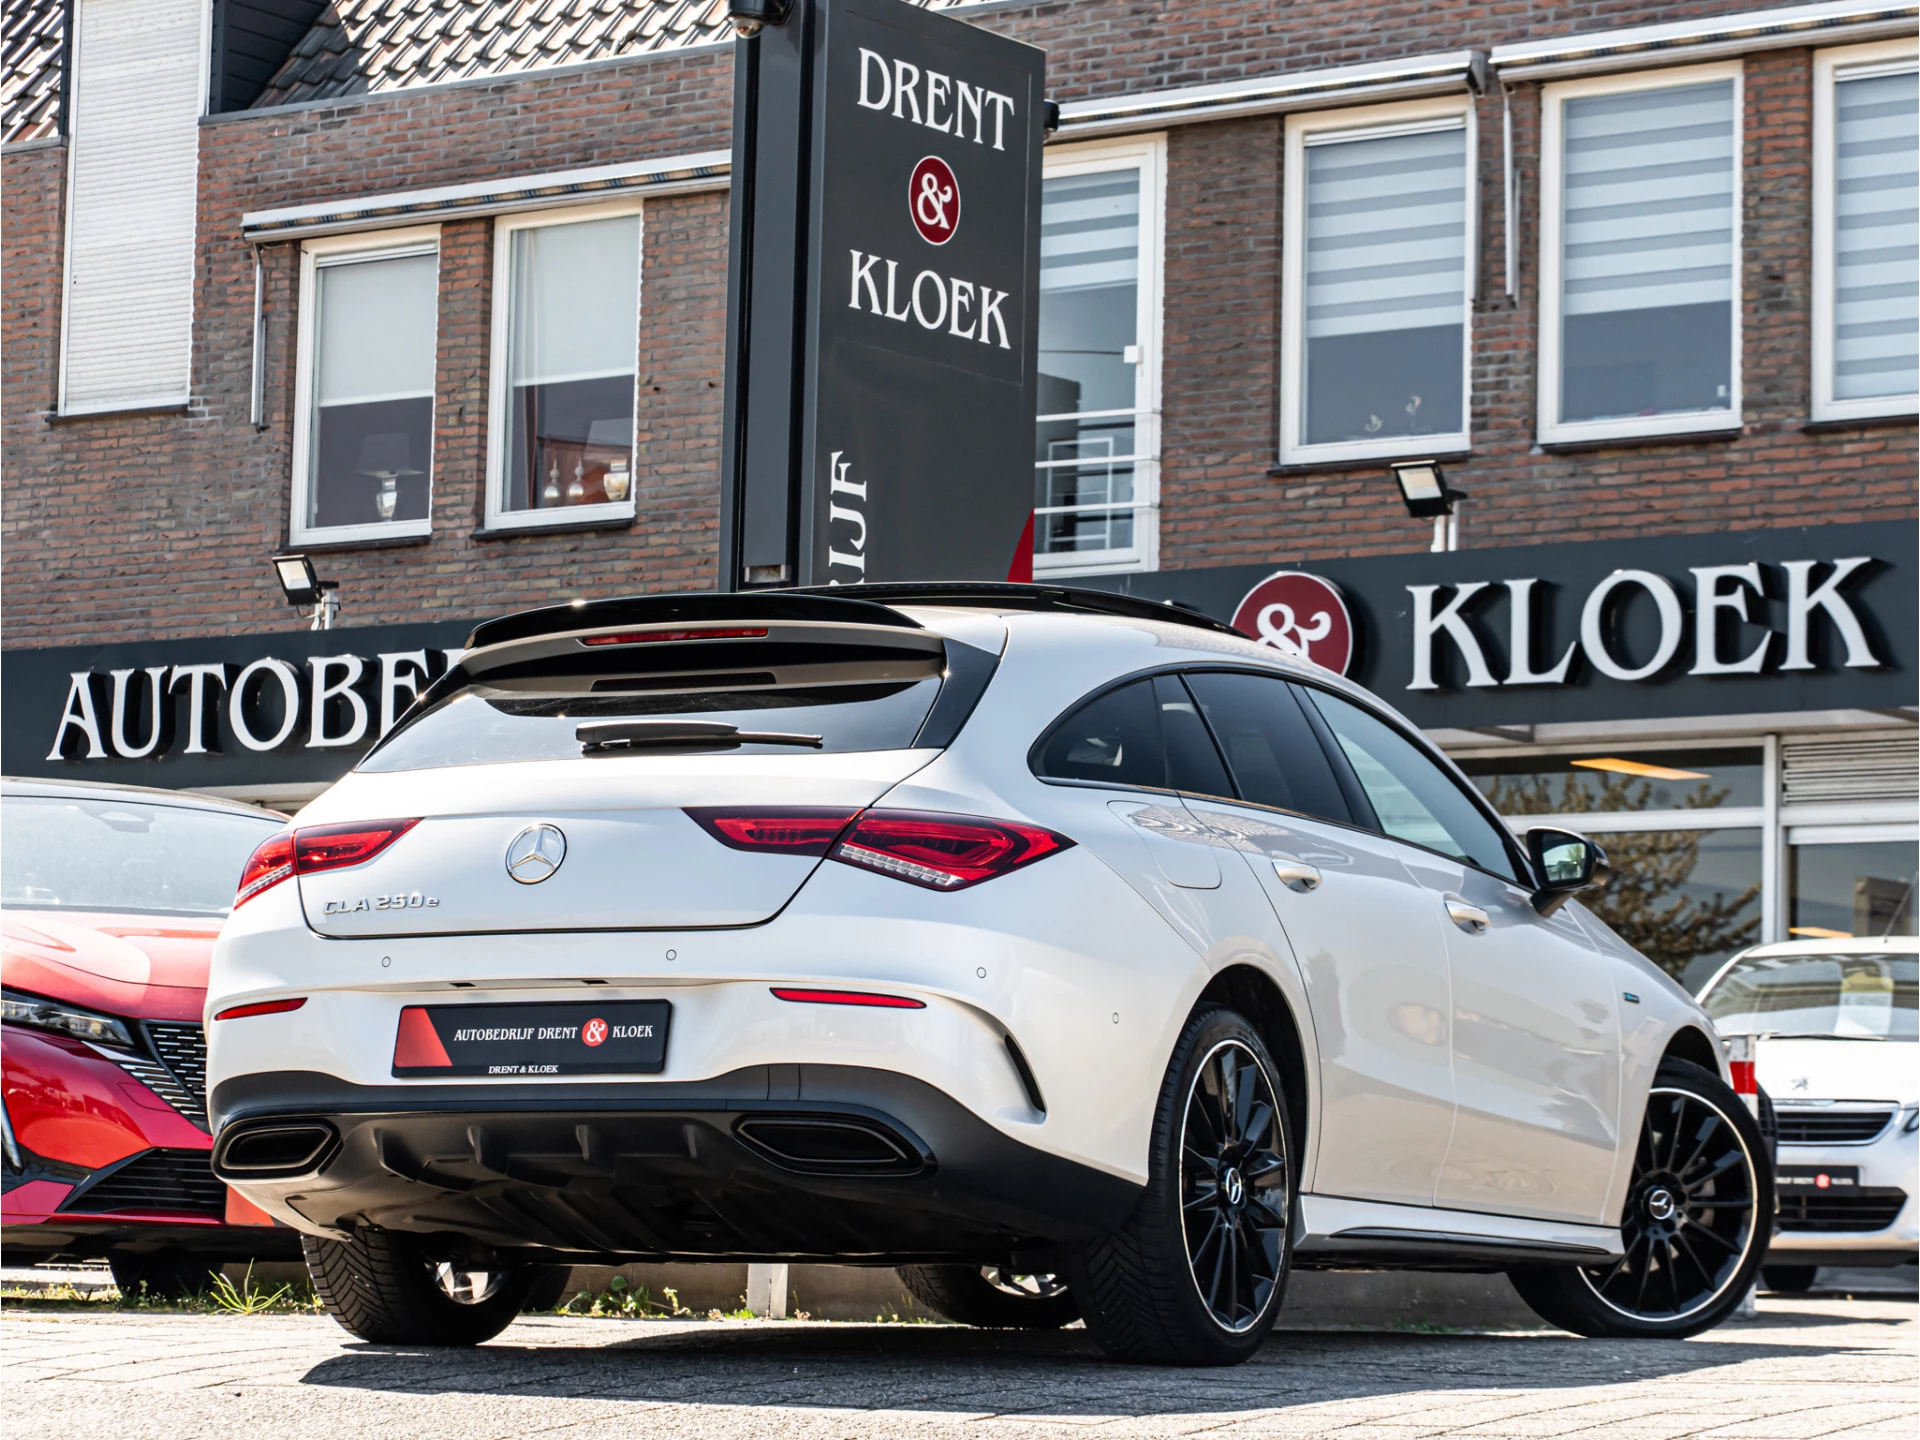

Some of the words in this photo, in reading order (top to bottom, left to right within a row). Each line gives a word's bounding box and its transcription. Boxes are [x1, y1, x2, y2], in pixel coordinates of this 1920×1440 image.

[857, 47, 1015, 151] DRENT
[917, 172, 953, 229] &
[848, 249, 1012, 350] KLOEK
[829, 450, 867, 585] IJF
[1256, 602, 1332, 662] &
[1406, 556, 1881, 690] KLOEK
[323, 897, 370, 914] CLA
[375, 891, 440, 911] 250e
[453, 1028, 535, 1042] AUTOBEDRIJF
[537, 1026, 578, 1040] DRENT
[586, 1020, 606, 1043] &
[612, 1025, 654, 1038] KLOEK
[488, 1065, 519, 1074] DRENT
[519, 1065, 527, 1074] &
[528, 1064, 559, 1073] KLOEK
